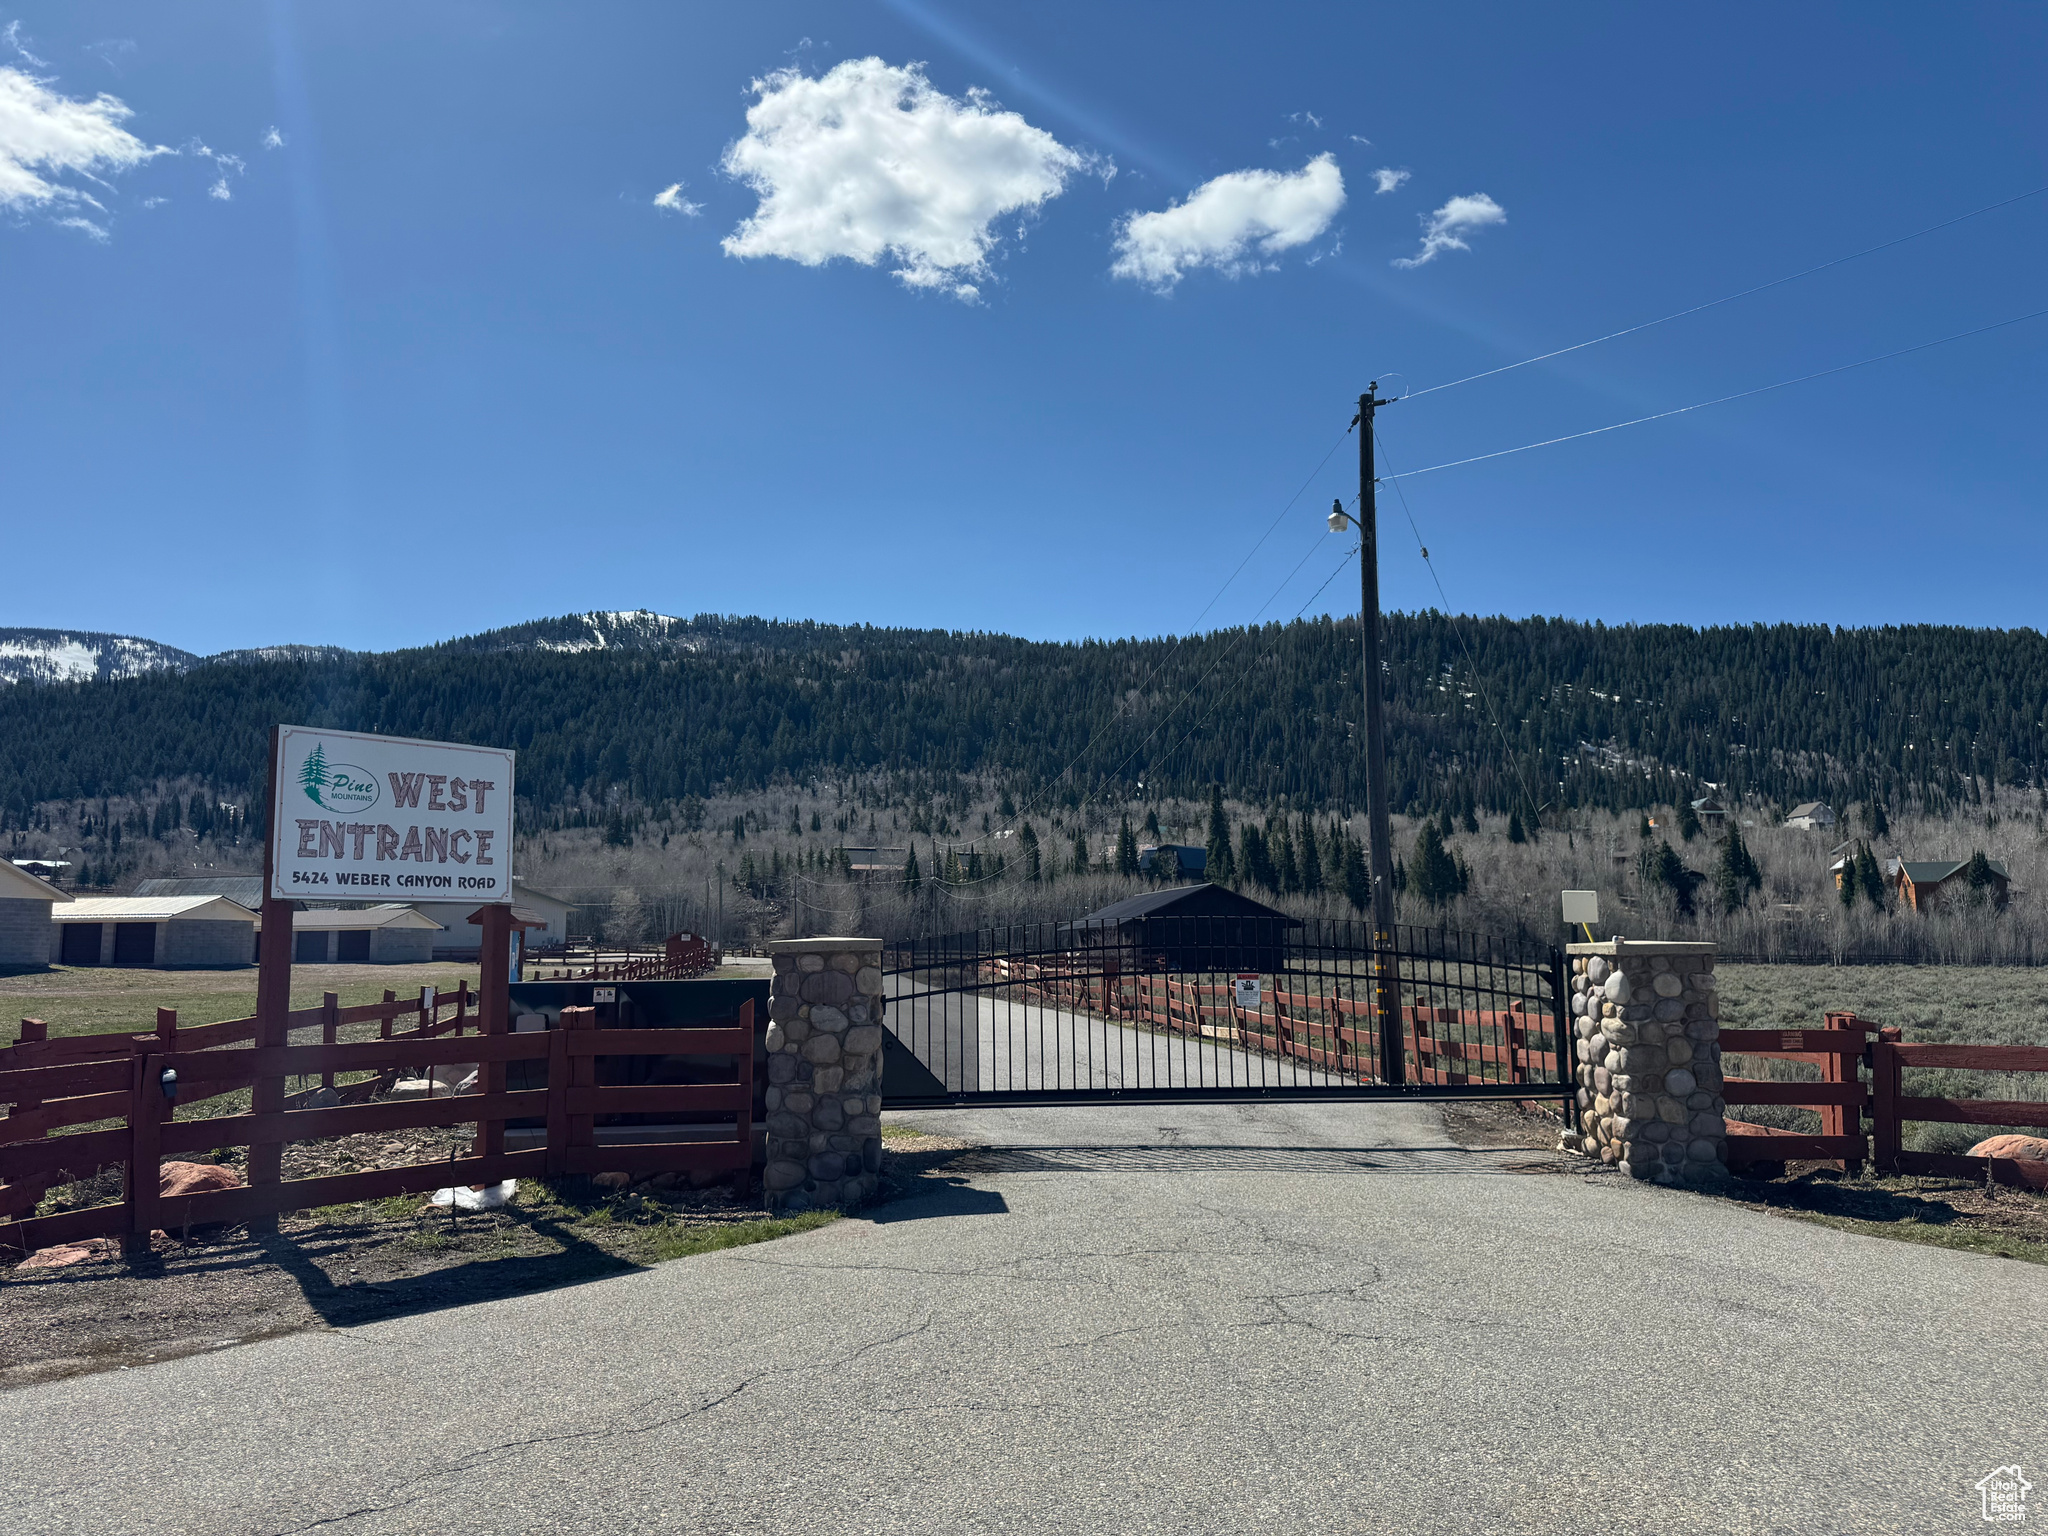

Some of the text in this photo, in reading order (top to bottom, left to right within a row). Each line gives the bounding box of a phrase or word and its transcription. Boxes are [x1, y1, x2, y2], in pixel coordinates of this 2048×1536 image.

[332, 774, 373, 793] Pine
[388, 772, 495, 814] WEST
[331, 793, 373, 802] MOUNTAINS
[295, 819, 494, 865] ENTRANCE
[292, 871, 496, 889] 5424 WEBER CANYON ROAD
